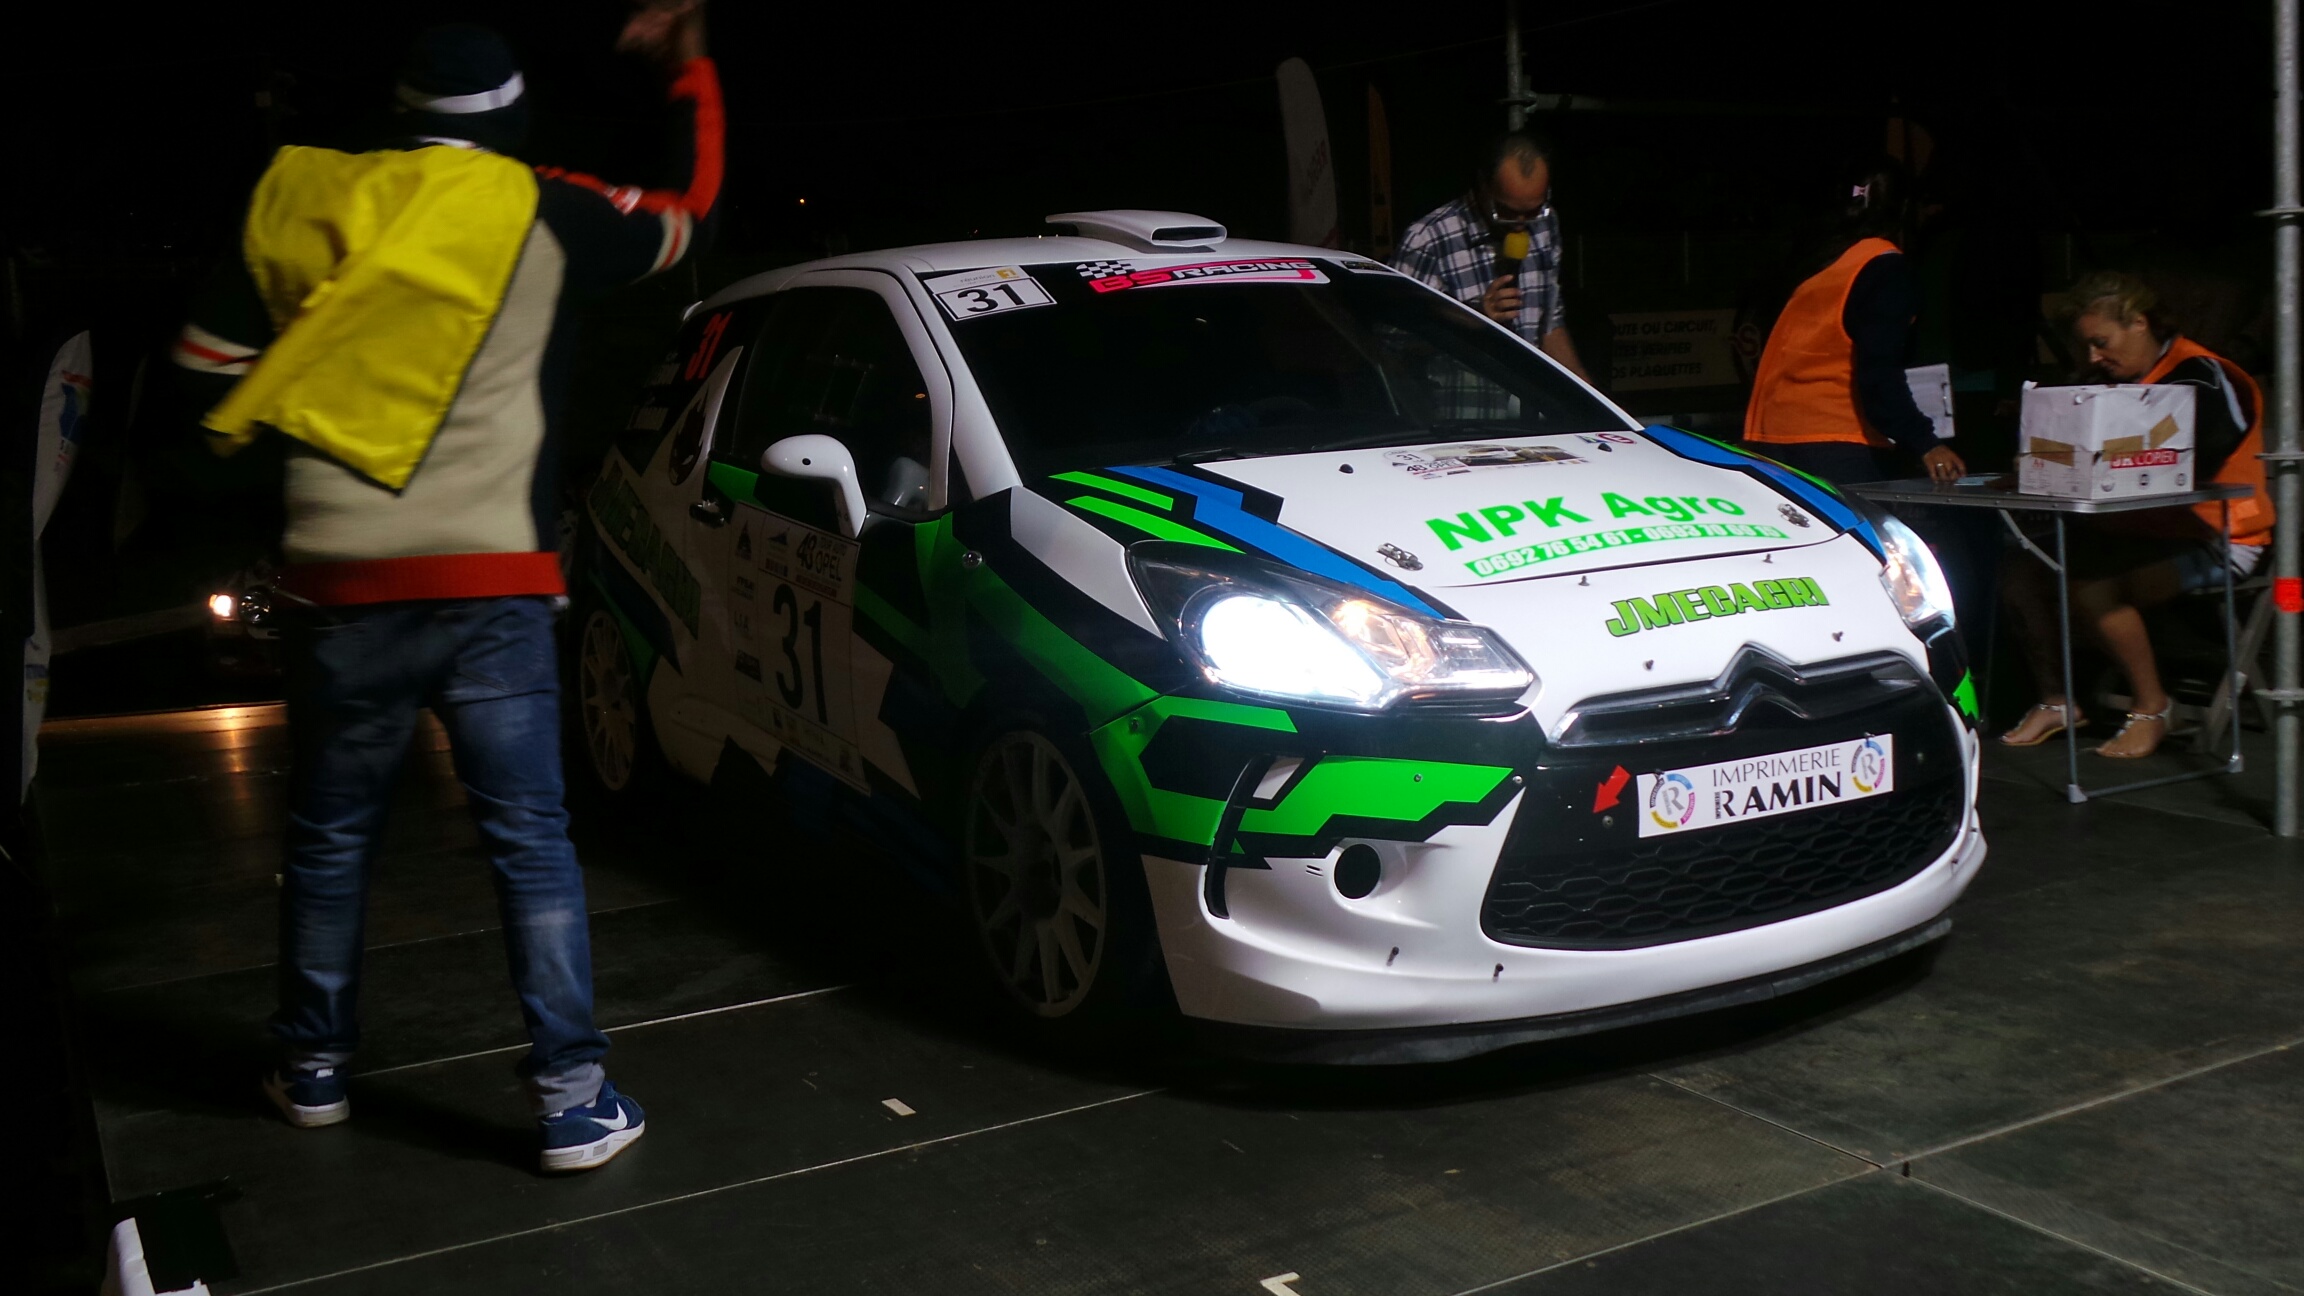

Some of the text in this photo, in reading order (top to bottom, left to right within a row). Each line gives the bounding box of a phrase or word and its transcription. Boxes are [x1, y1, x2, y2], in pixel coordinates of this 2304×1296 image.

[957, 283, 1026, 313] 31
[1087, 270, 1172, 294] BS
[1172, 259, 1317, 279] RACING
[684, 310, 736, 382] 31
[1640, 321, 1662, 336] OU
[1629, 362, 1703, 380] PLAQUETTES
[1426, 491, 1746, 551] NPK Agro
[815, 550, 842, 582] OPEL
[1474, 547, 1540, 576] 0692
[1538, 540, 1571, 558] 76
[1569, 534, 1605, 552] 54
[1602, 529, 1633, 546] 61
[1642, 524, 1702, 541] 0693
[1725, 524, 1757, 537] 69
[1605, 577, 1830, 638] JMECAGRI
[773, 583, 828, 726] 31
[1712, 747, 1842, 788] IMPRIMERIE
[1715, 771, 1841, 820] RAMIN
